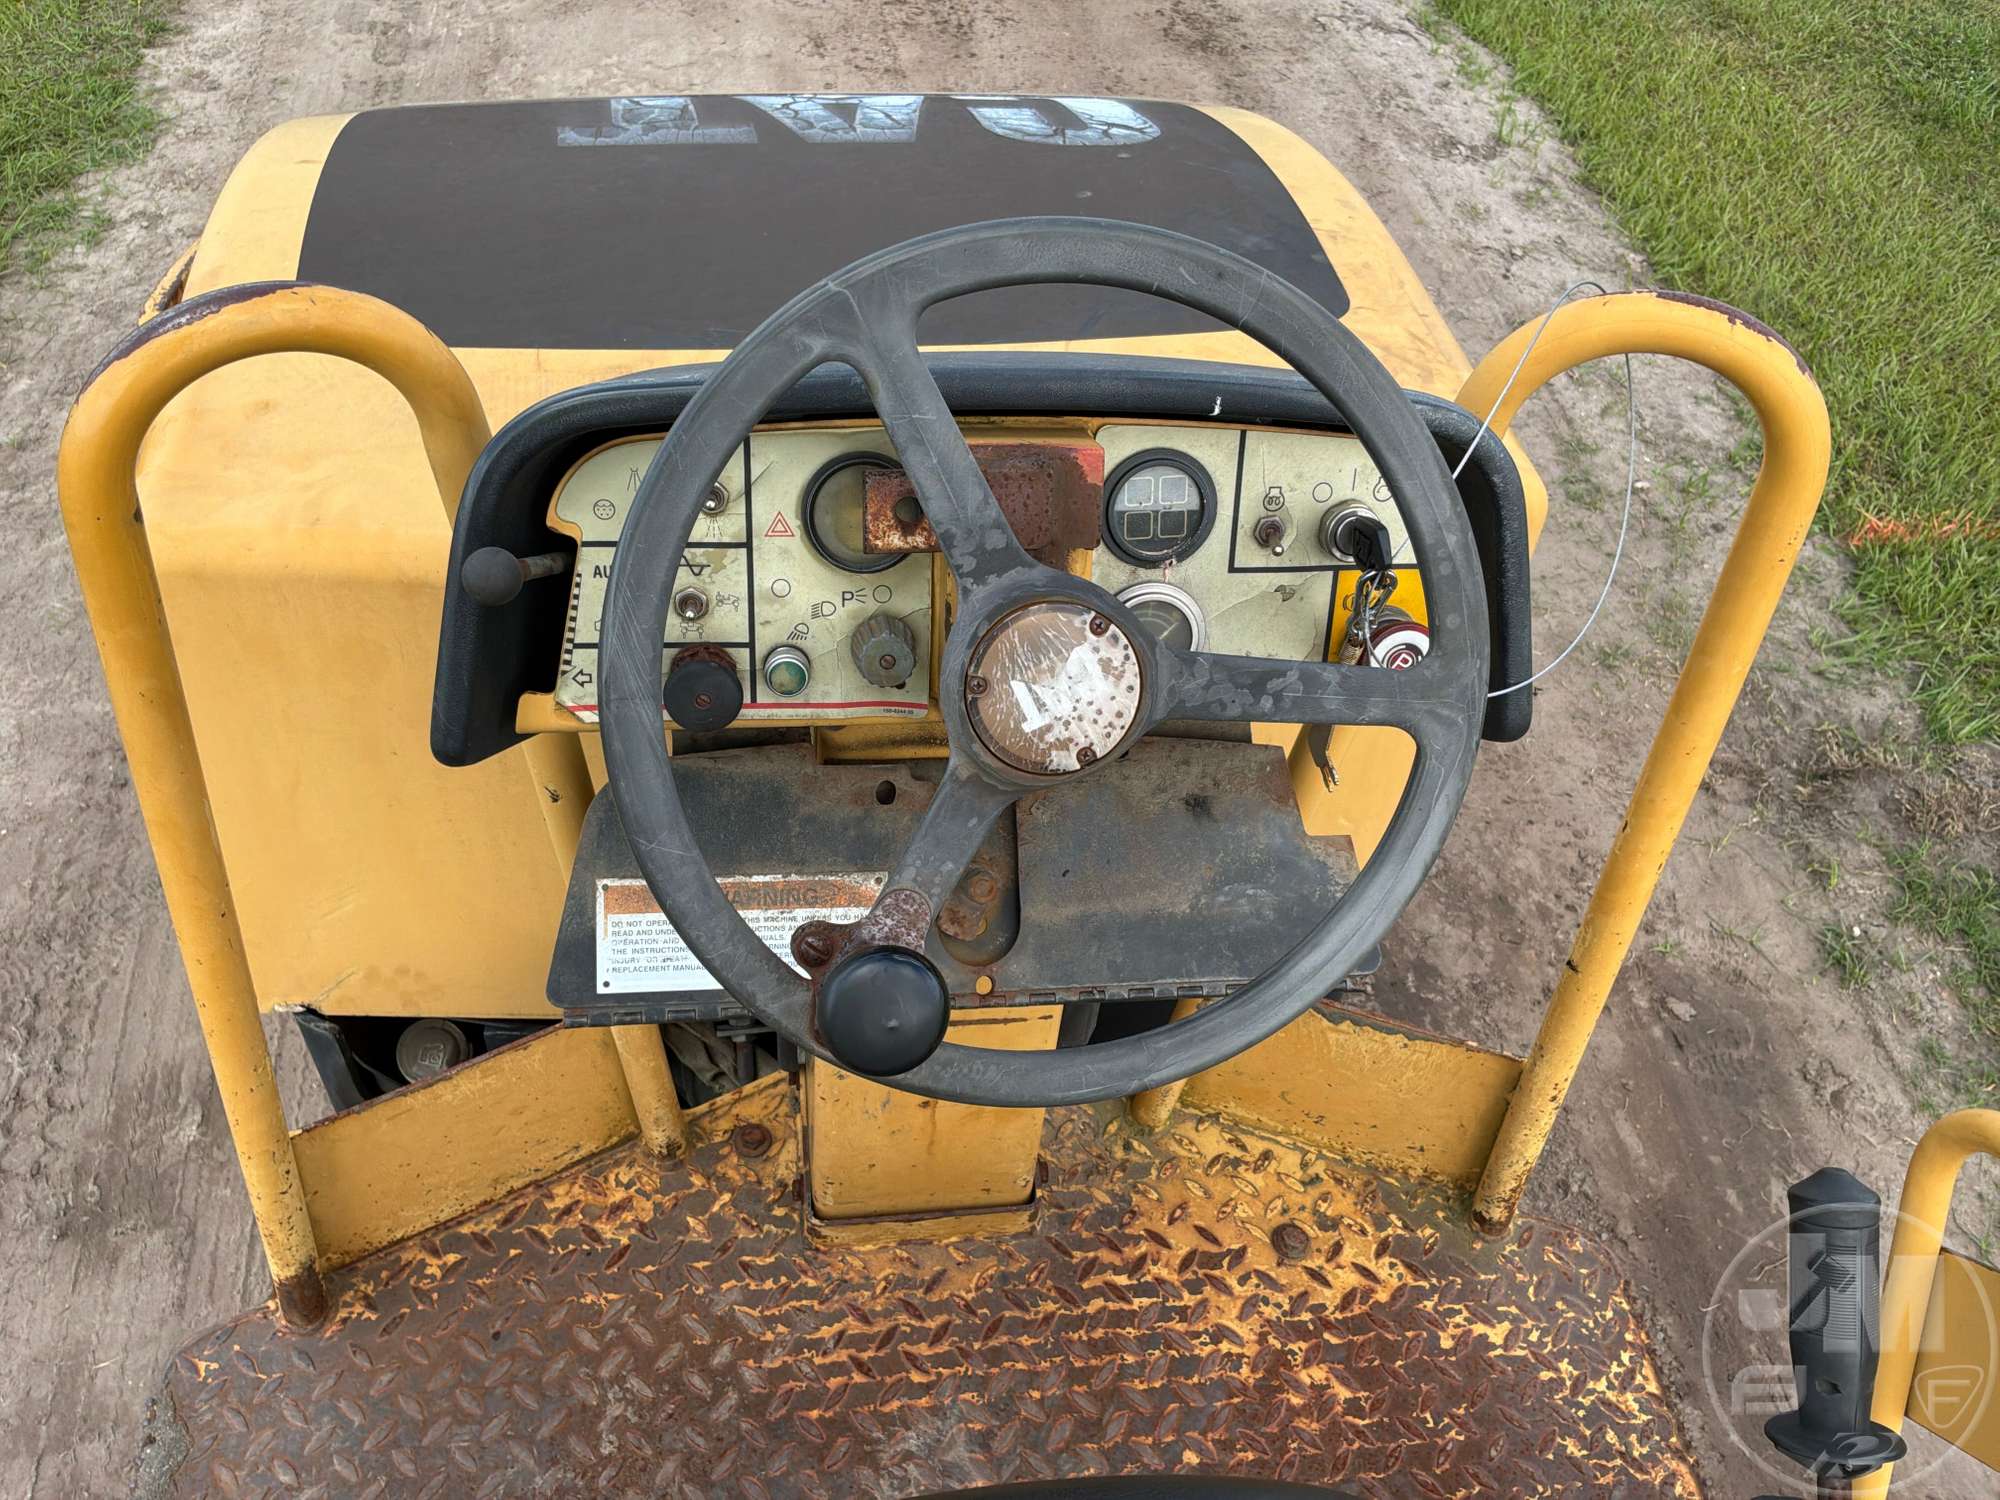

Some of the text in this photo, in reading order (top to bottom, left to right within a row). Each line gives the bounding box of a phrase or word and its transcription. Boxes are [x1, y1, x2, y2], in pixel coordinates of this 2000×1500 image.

[593, 564, 611, 578] AU
[836, 913, 851, 921] YOU
[611, 919, 670, 929] DO NOT OPER
[611, 930, 634, 938] READ
[636, 929, 653, 937] AND
[611, 936, 680, 947] OPERATION AND
[611, 948, 628, 956] THE
[611, 965, 670, 974] REPLACEMENT
